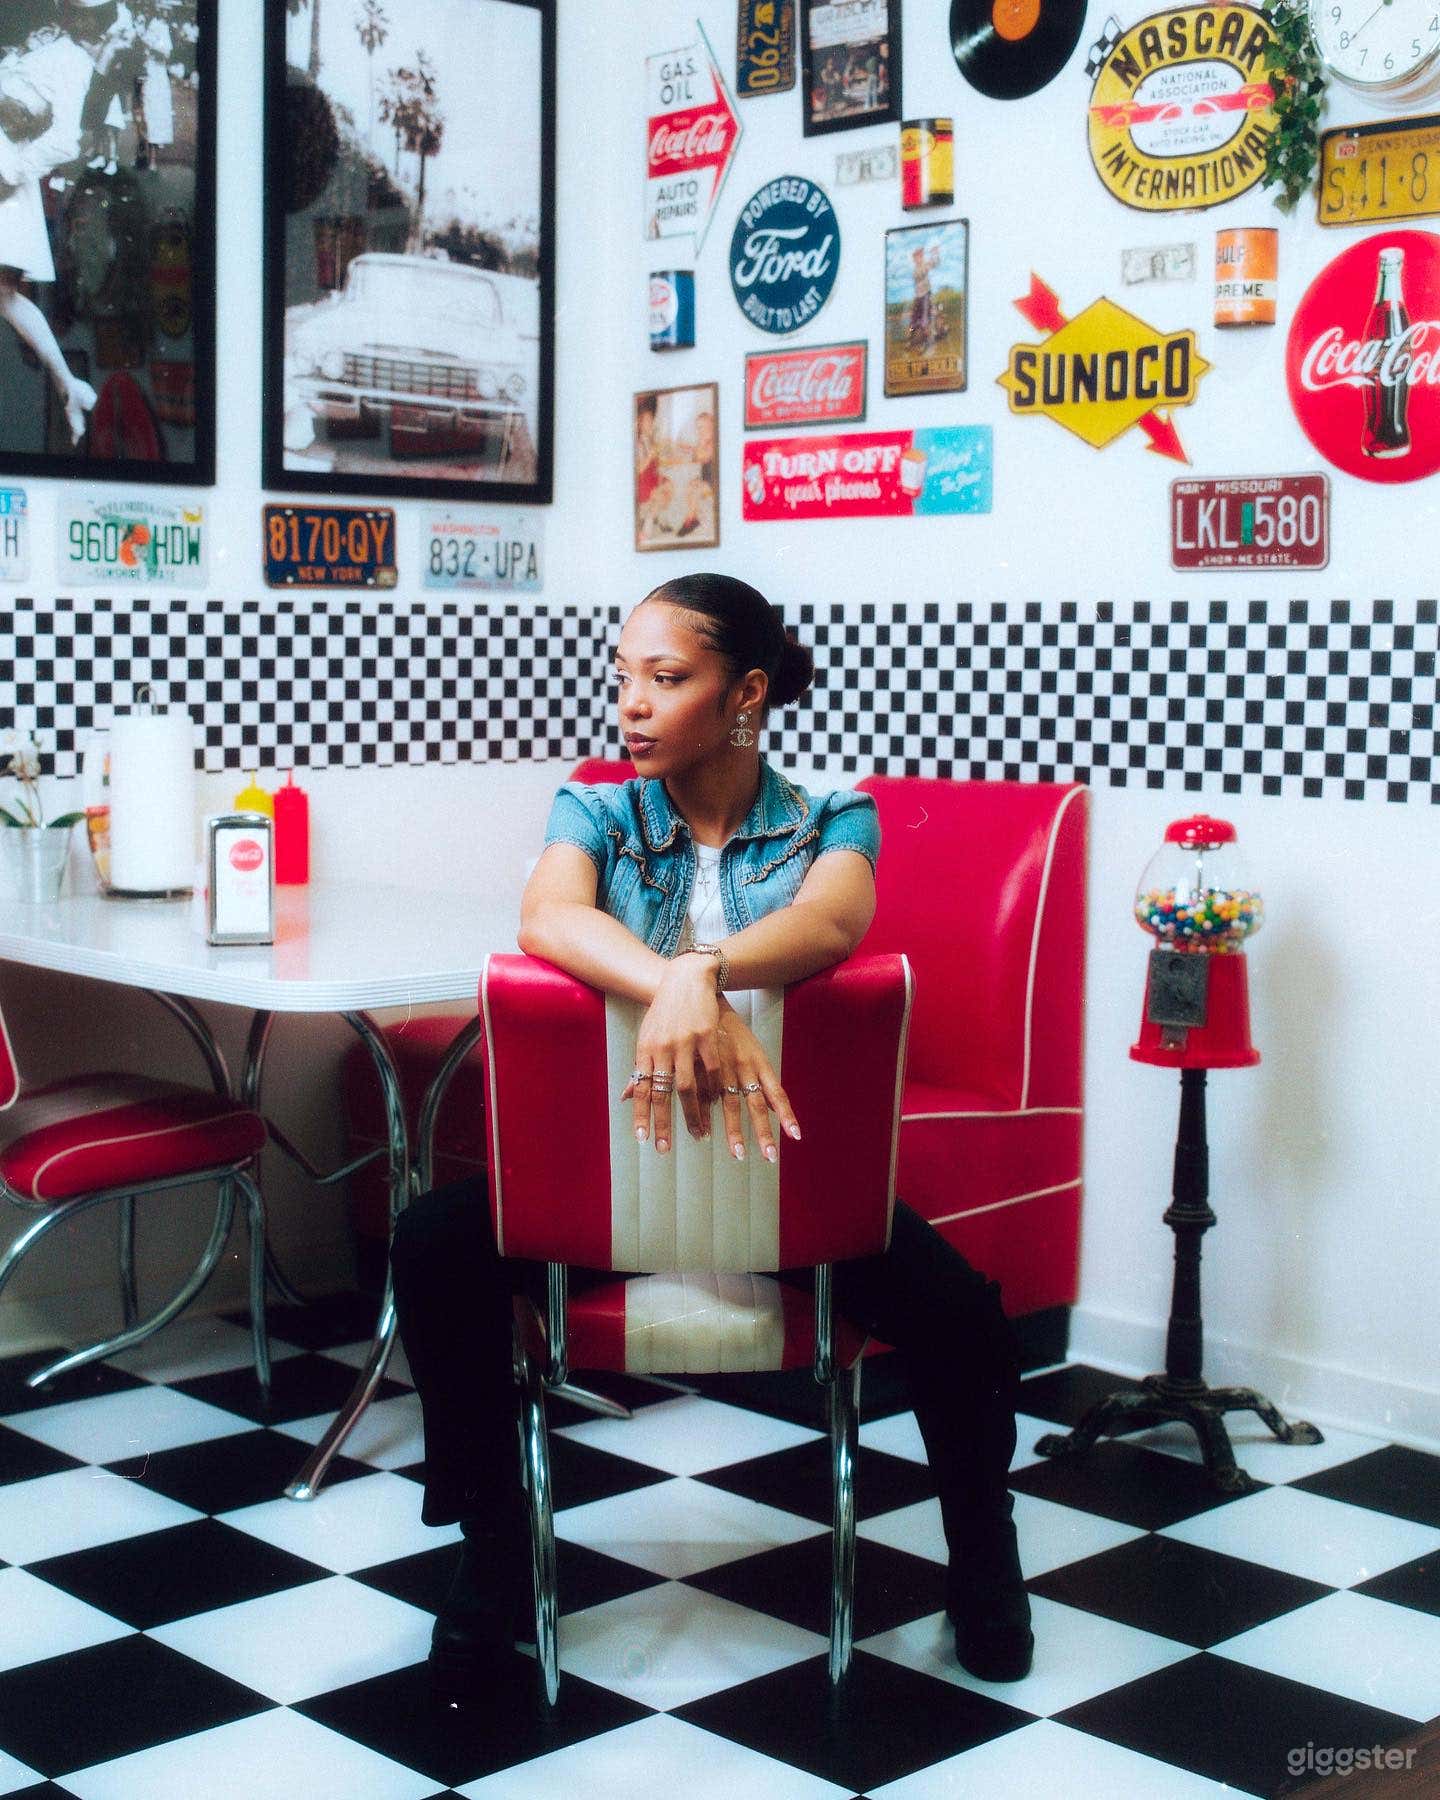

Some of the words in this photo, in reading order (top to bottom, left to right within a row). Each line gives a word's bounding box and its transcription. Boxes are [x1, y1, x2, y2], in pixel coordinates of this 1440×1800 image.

[1331, 6, 1342, 25] 9
[1110, 11, 1272, 89] NASCAR
[1339, 31, 1350, 49] 8
[1411, 38, 1420, 58] 5
[1360, 48, 1369, 67] 7
[1383, 51, 1393, 70] 6
[660, 58, 696, 82] GAS
[1161, 70, 1217, 86] NATIONAL
[660, 80, 692, 105] OIL
[1150, 80, 1227, 99] ASSOCIATION
[1101, 122, 1274, 201] INTERNATIONAL
[657, 180, 698, 202] AUTO
[742, 179, 808, 229] POWERED
[806, 190, 830, 218] BY
[735, 225, 834, 288] Ford
[791, 286, 822, 324] LAST
[1014, 336, 1191, 407] SUNOCO
[762, 448, 837, 480] TURN
[842, 444, 902, 473] OFF
[1214, 478, 1283, 494] MISSOURI
[1176, 497, 1240, 549] LKL
[1254, 494, 1320, 548] 580
[70, 520, 119, 562] 960
[152, 524, 201, 565] HDW
[298, 566, 327, 581] NEW
[329, 567, 363, 581] YORK
